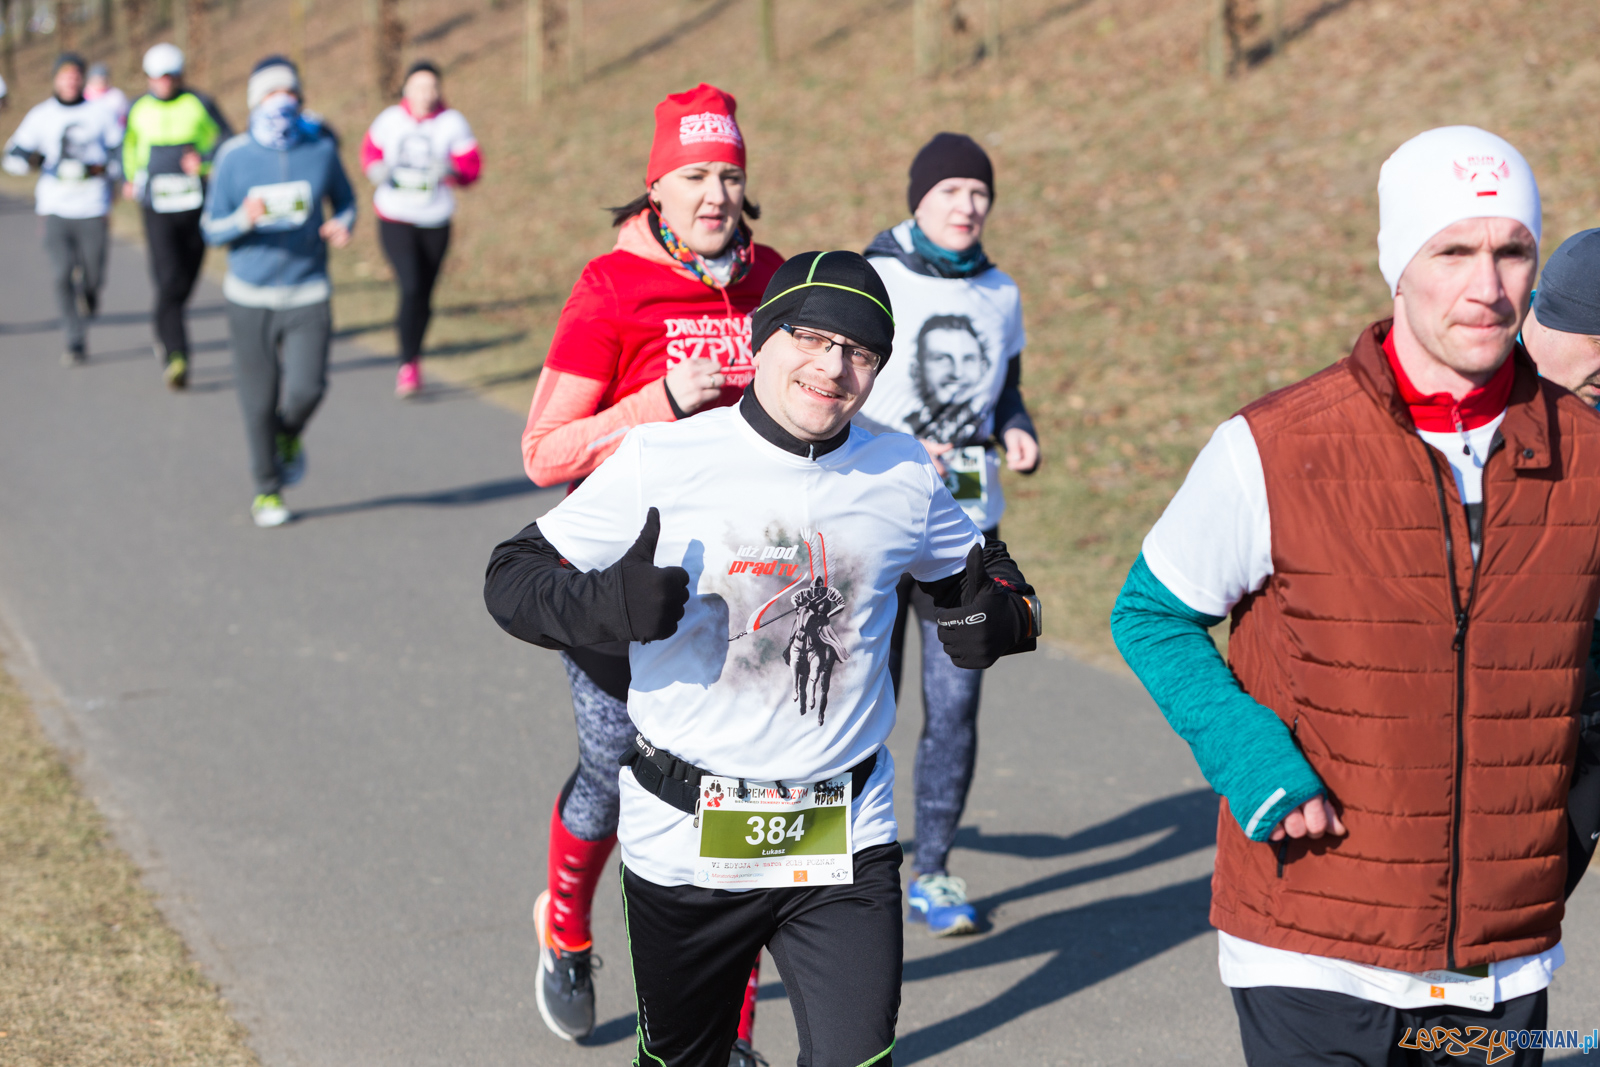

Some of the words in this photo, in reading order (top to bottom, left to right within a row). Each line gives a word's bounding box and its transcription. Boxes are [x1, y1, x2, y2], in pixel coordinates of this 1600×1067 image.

[664, 314, 753, 338] DRUŻYNA
[760, 545, 799, 560] pod
[727, 560, 778, 577] prąd
[745, 814, 805, 845] 384
